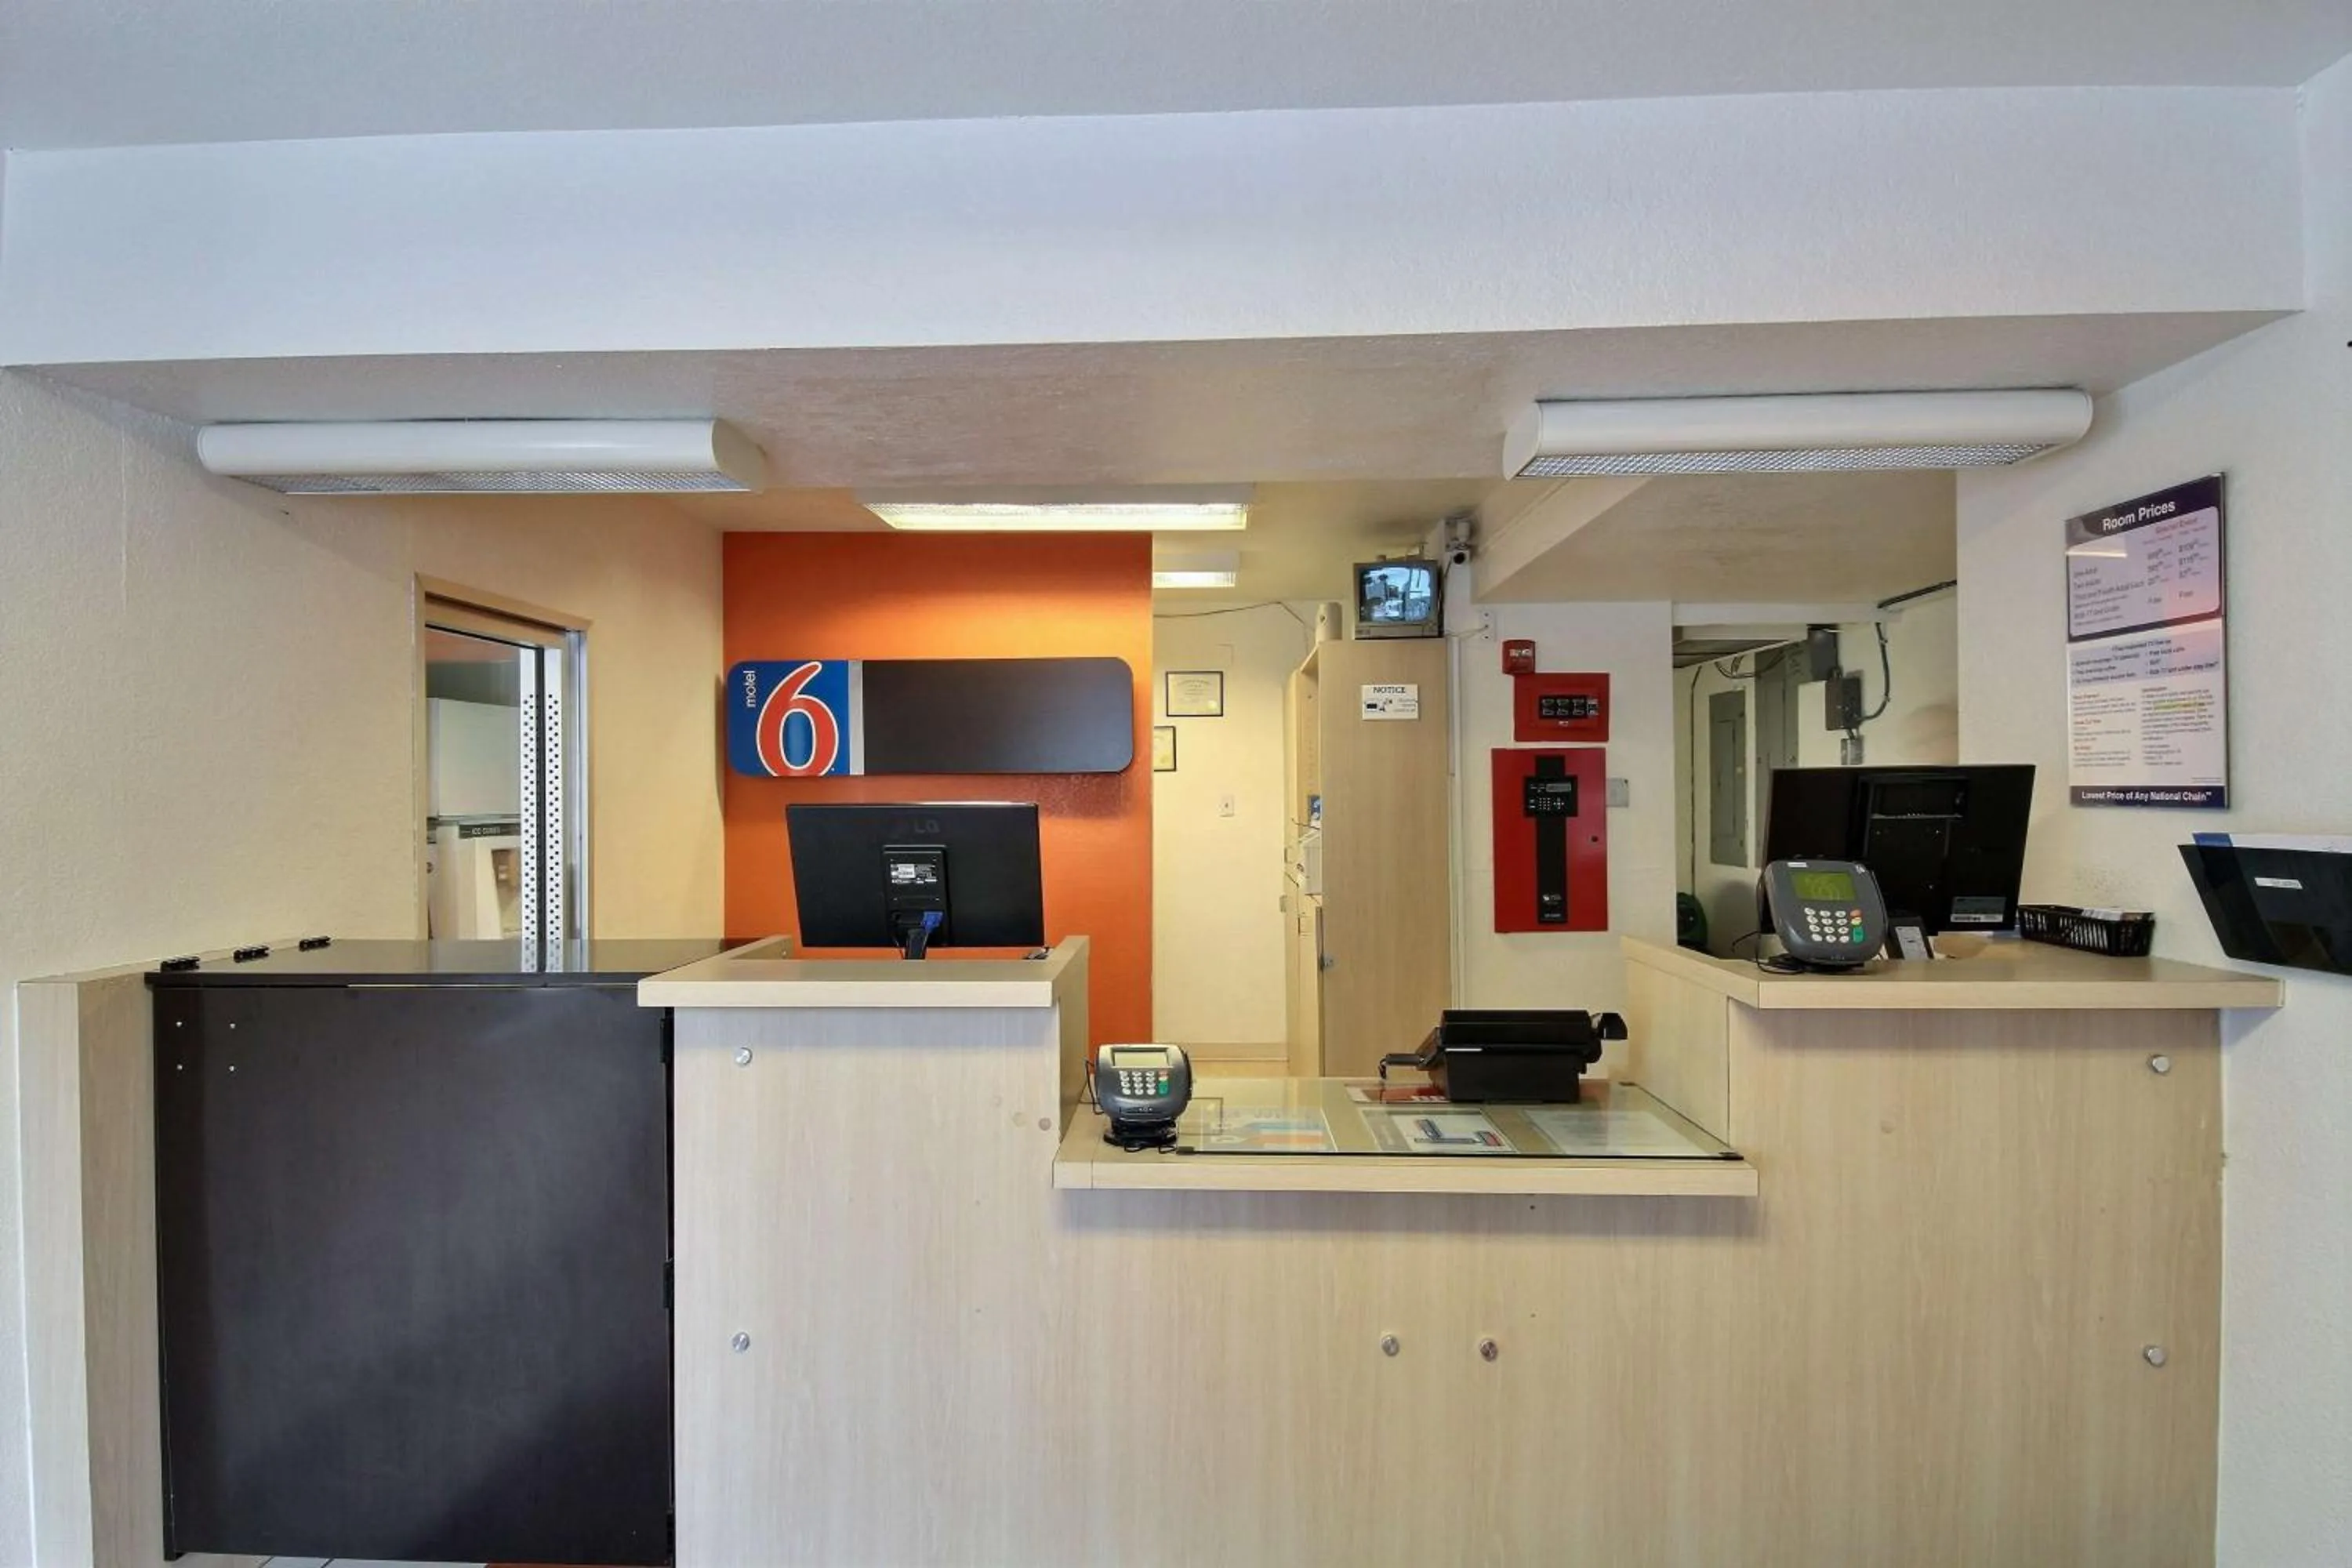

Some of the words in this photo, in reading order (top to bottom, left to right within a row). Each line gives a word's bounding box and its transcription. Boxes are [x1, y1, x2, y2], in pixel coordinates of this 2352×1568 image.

[2103, 513, 2136, 531] Room
[2137, 501, 2176, 521] Prices
[742, 670, 757, 708] motel
[756, 661, 840, 776] 6
[2135, 791, 2149, 802] Any
[2150, 791, 2181, 800] National
